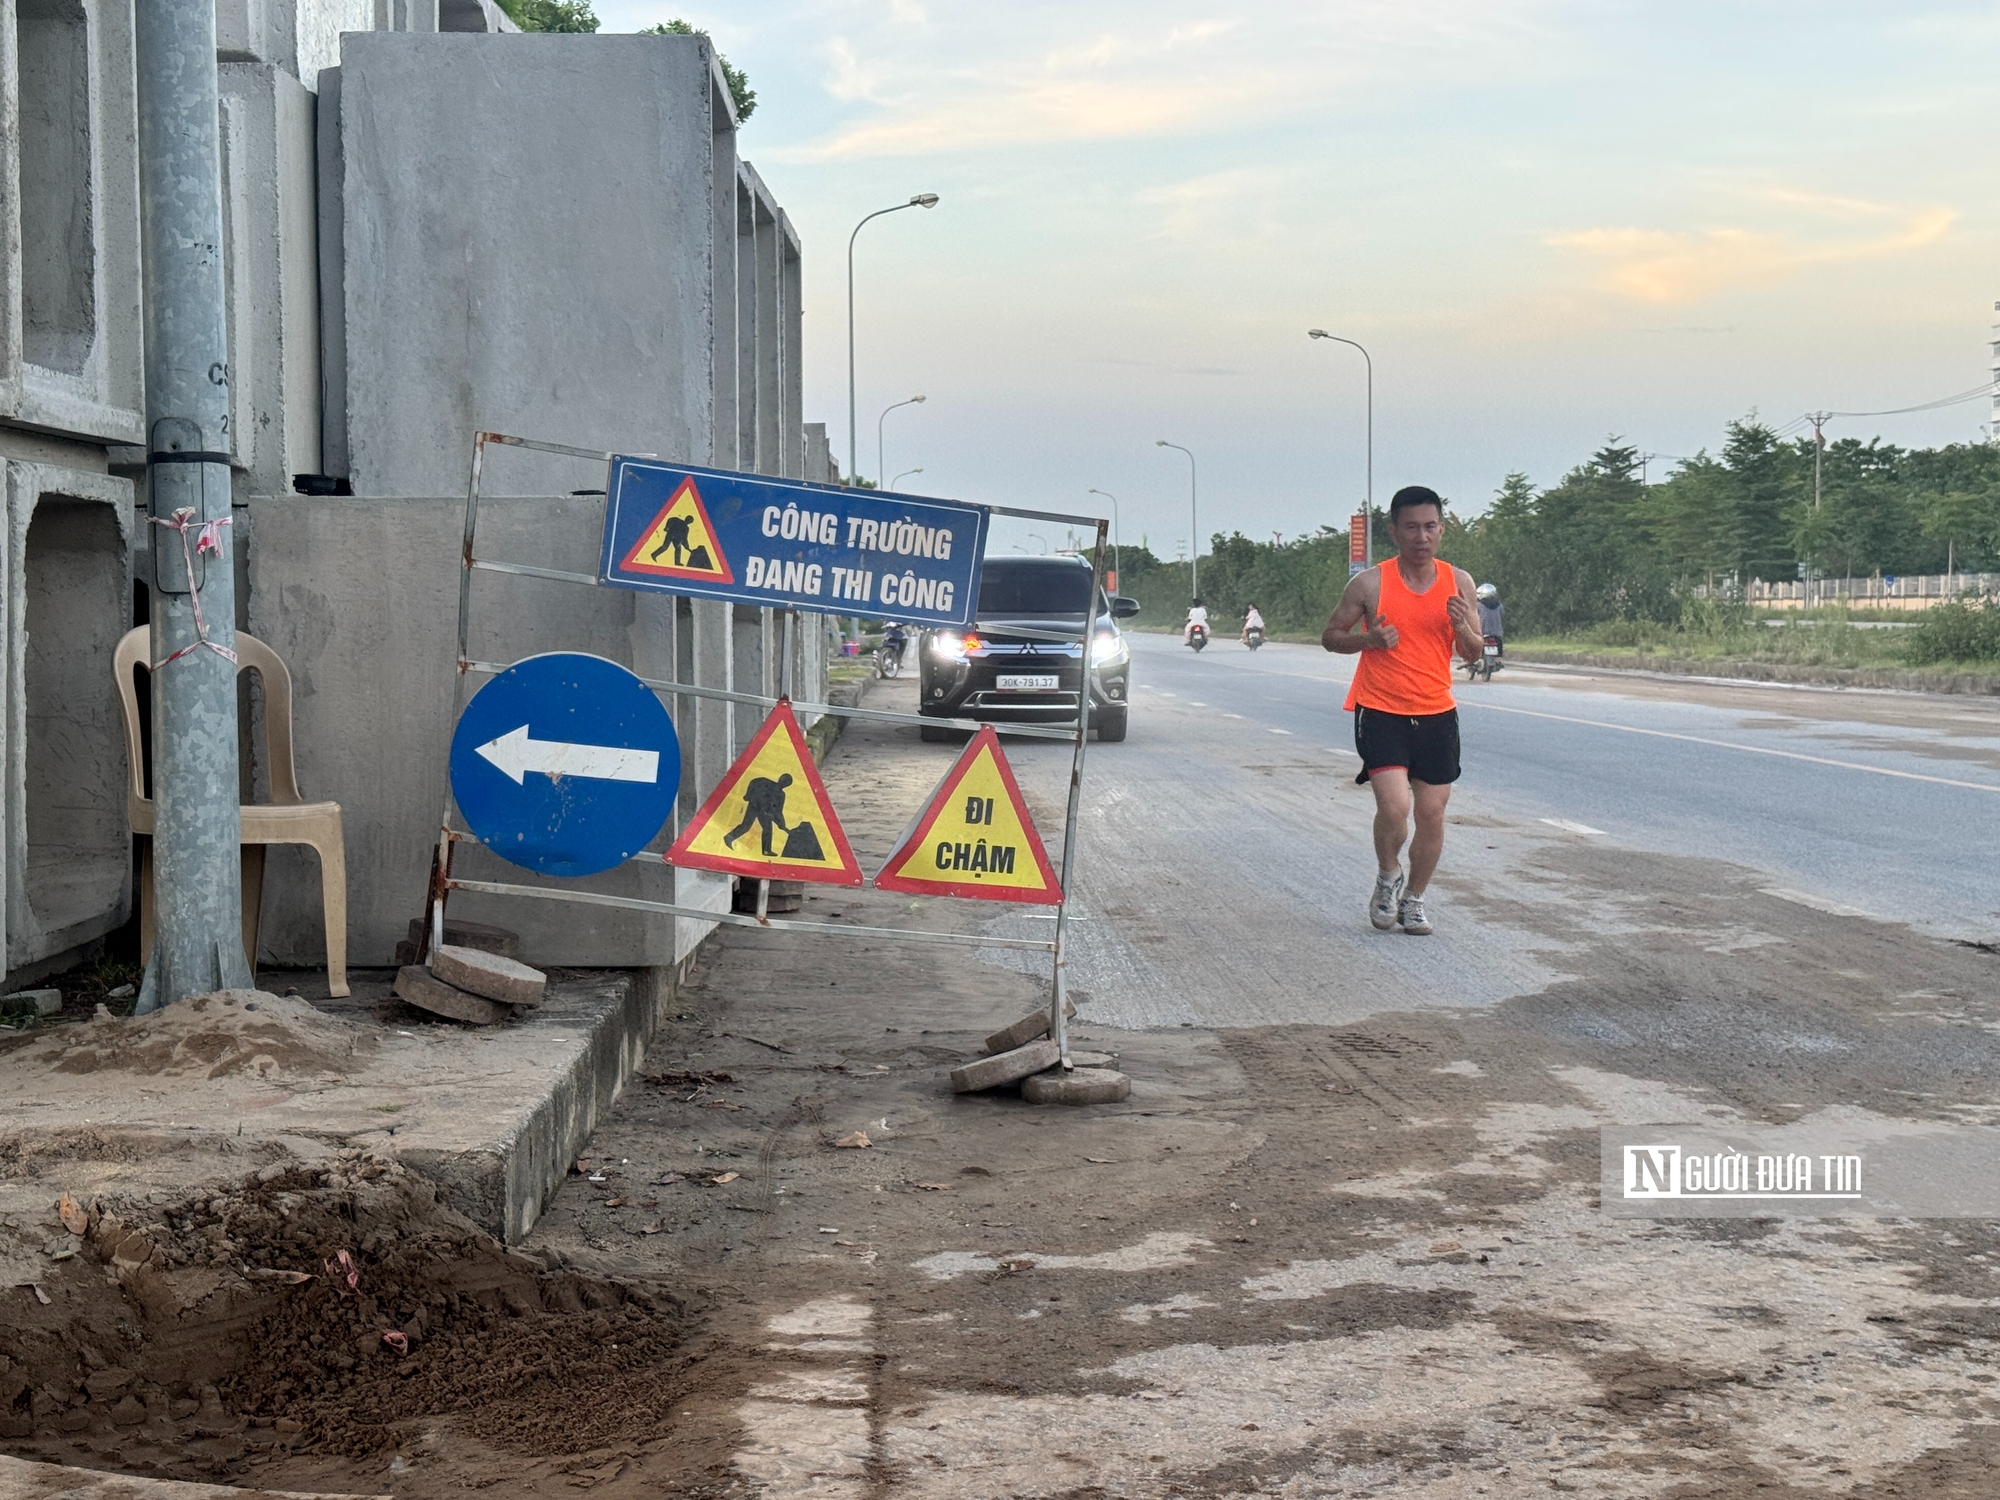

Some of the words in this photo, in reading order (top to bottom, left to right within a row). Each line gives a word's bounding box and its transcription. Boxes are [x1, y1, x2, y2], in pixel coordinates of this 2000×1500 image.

[761, 501, 837, 546] CÔNG
[846, 515, 953, 561] TRƯỜNG
[745, 556, 821, 596] ĐANG
[831, 566, 872, 602] THI
[880, 570, 955, 612] CÔNG
[965, 796, 994, 825] ĐI
[935, 838, 1016, 879] CHẬM
